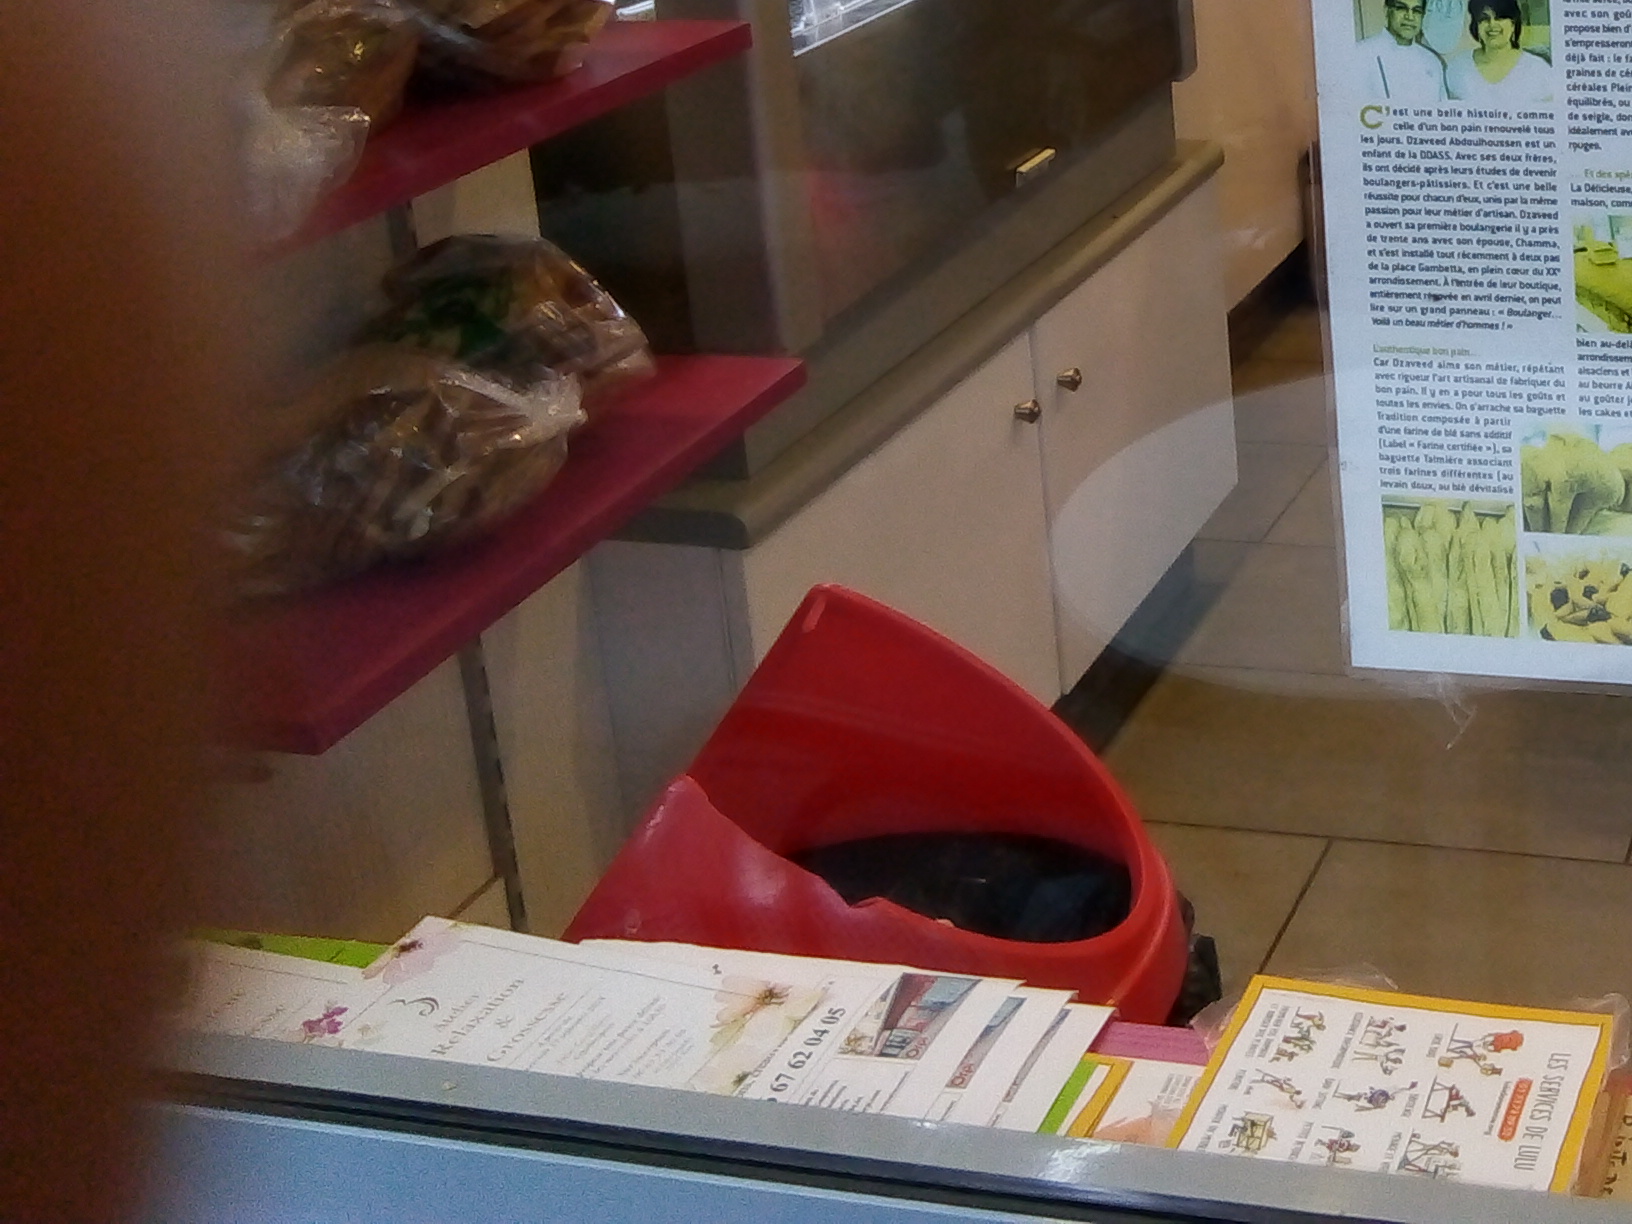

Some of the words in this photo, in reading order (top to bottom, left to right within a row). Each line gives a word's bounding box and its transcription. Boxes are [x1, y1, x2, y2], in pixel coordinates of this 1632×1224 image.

[1563, 10, 1587, 19] avec
[1590, 10, 1609, 19] son
[1566, 67, 1602, 81] graines
[1604, 68, 1616, 79] de
[1566, 81, 1607, 93] céréales
[1413, 110, 1432, 119] une
[1436, 108, 1462, 119] belle
[1466, 108, 1514, 120] histoire,
[1516, 111, 1554, 121] comme
[1360, 134, 1374, 145] les
[1376, 134, 1402, 148] jours.
[1406, 135, 1446, 147] Dzaveed
[1524, 137, 1540, 149] est
[1543, 140, 1555, 149] un
[1570, 182, 1581, 193] La
[430, 977, 525, 1057] Relaxation
[486, 991, 567, 1063] Grossesse
[769, 1072, 796, 1093] 67
[788, 1050, 813, 1070] 62
[804, 1026, 829, 1048] 04
[821, 1006, 847, 1027] 05
[1546, 1052, 1572, 1071] LES
[1530, 1075, 1564, 1122] SERVICES
[1522, 1125, 1549, 1140] DE
[1513, 1145, 1542, 1171] LULU
